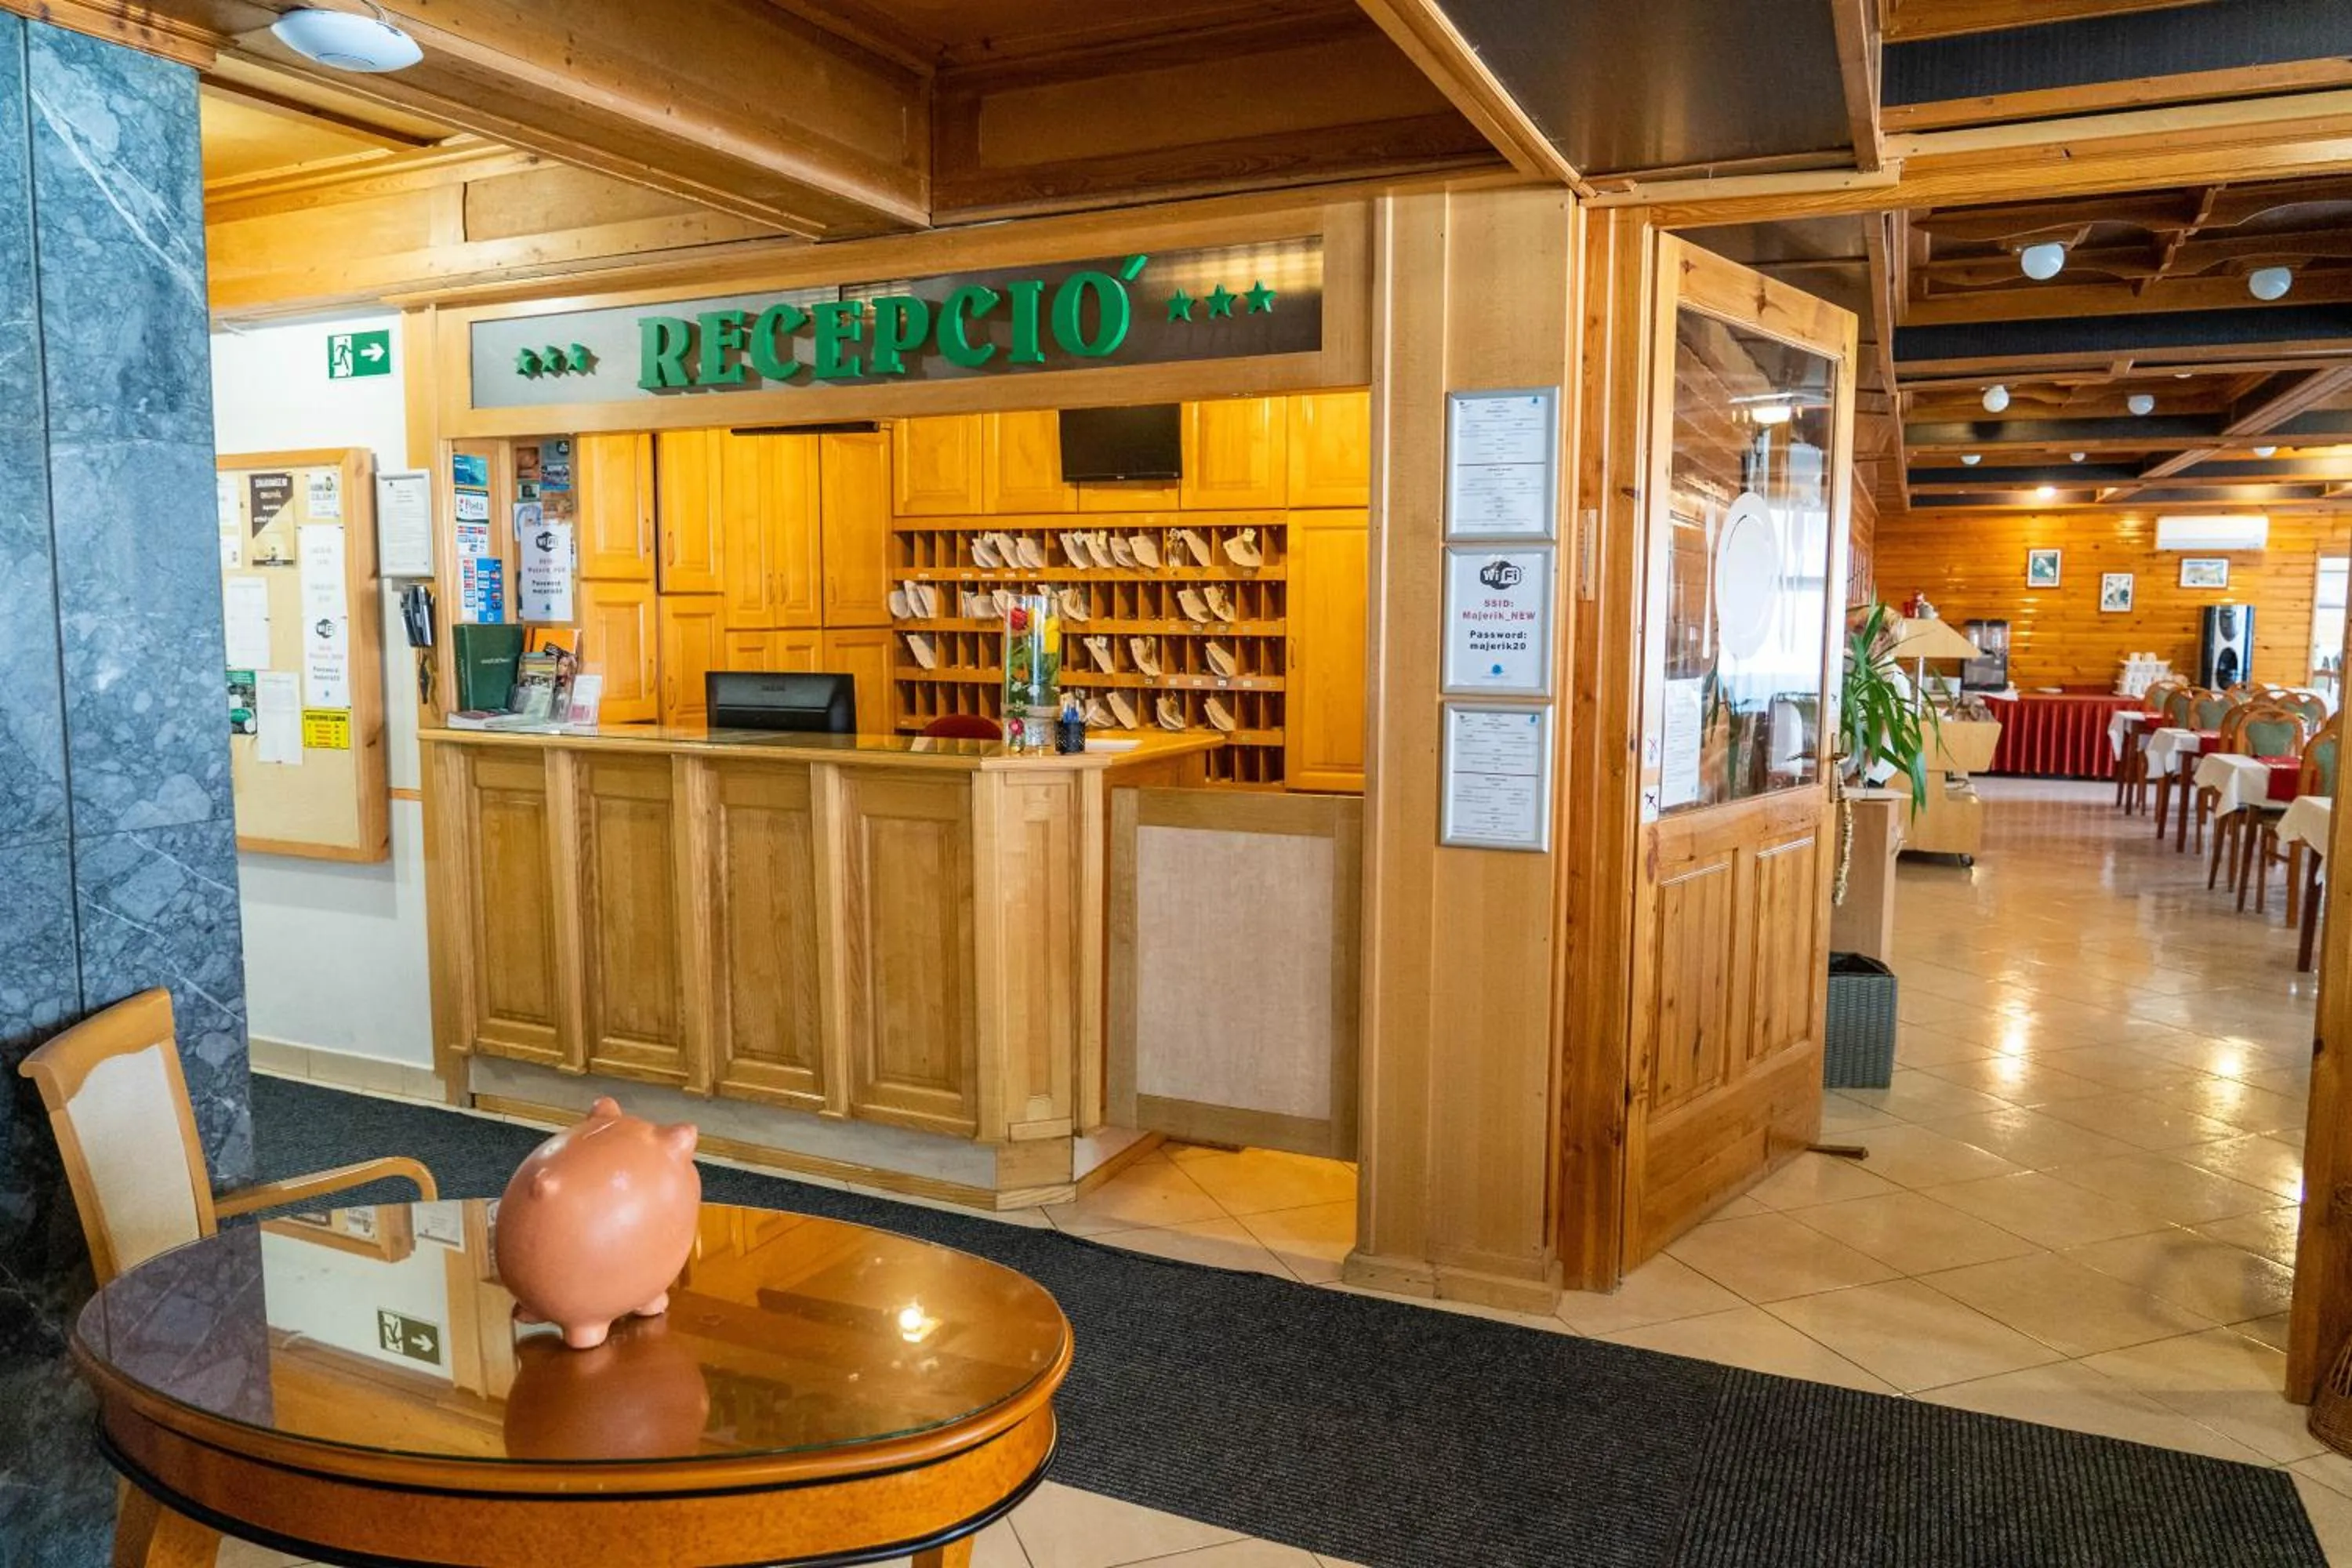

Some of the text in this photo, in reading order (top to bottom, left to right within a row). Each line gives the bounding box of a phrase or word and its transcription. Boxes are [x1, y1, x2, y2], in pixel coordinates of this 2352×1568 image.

[637, 254, 1148, 389] RECEPCIÓ
[1483, 568, 1519, 582] WiFi
[1470, 630, 1527, 639] Password:
[1470, 642, 1526, 651] majerik20
